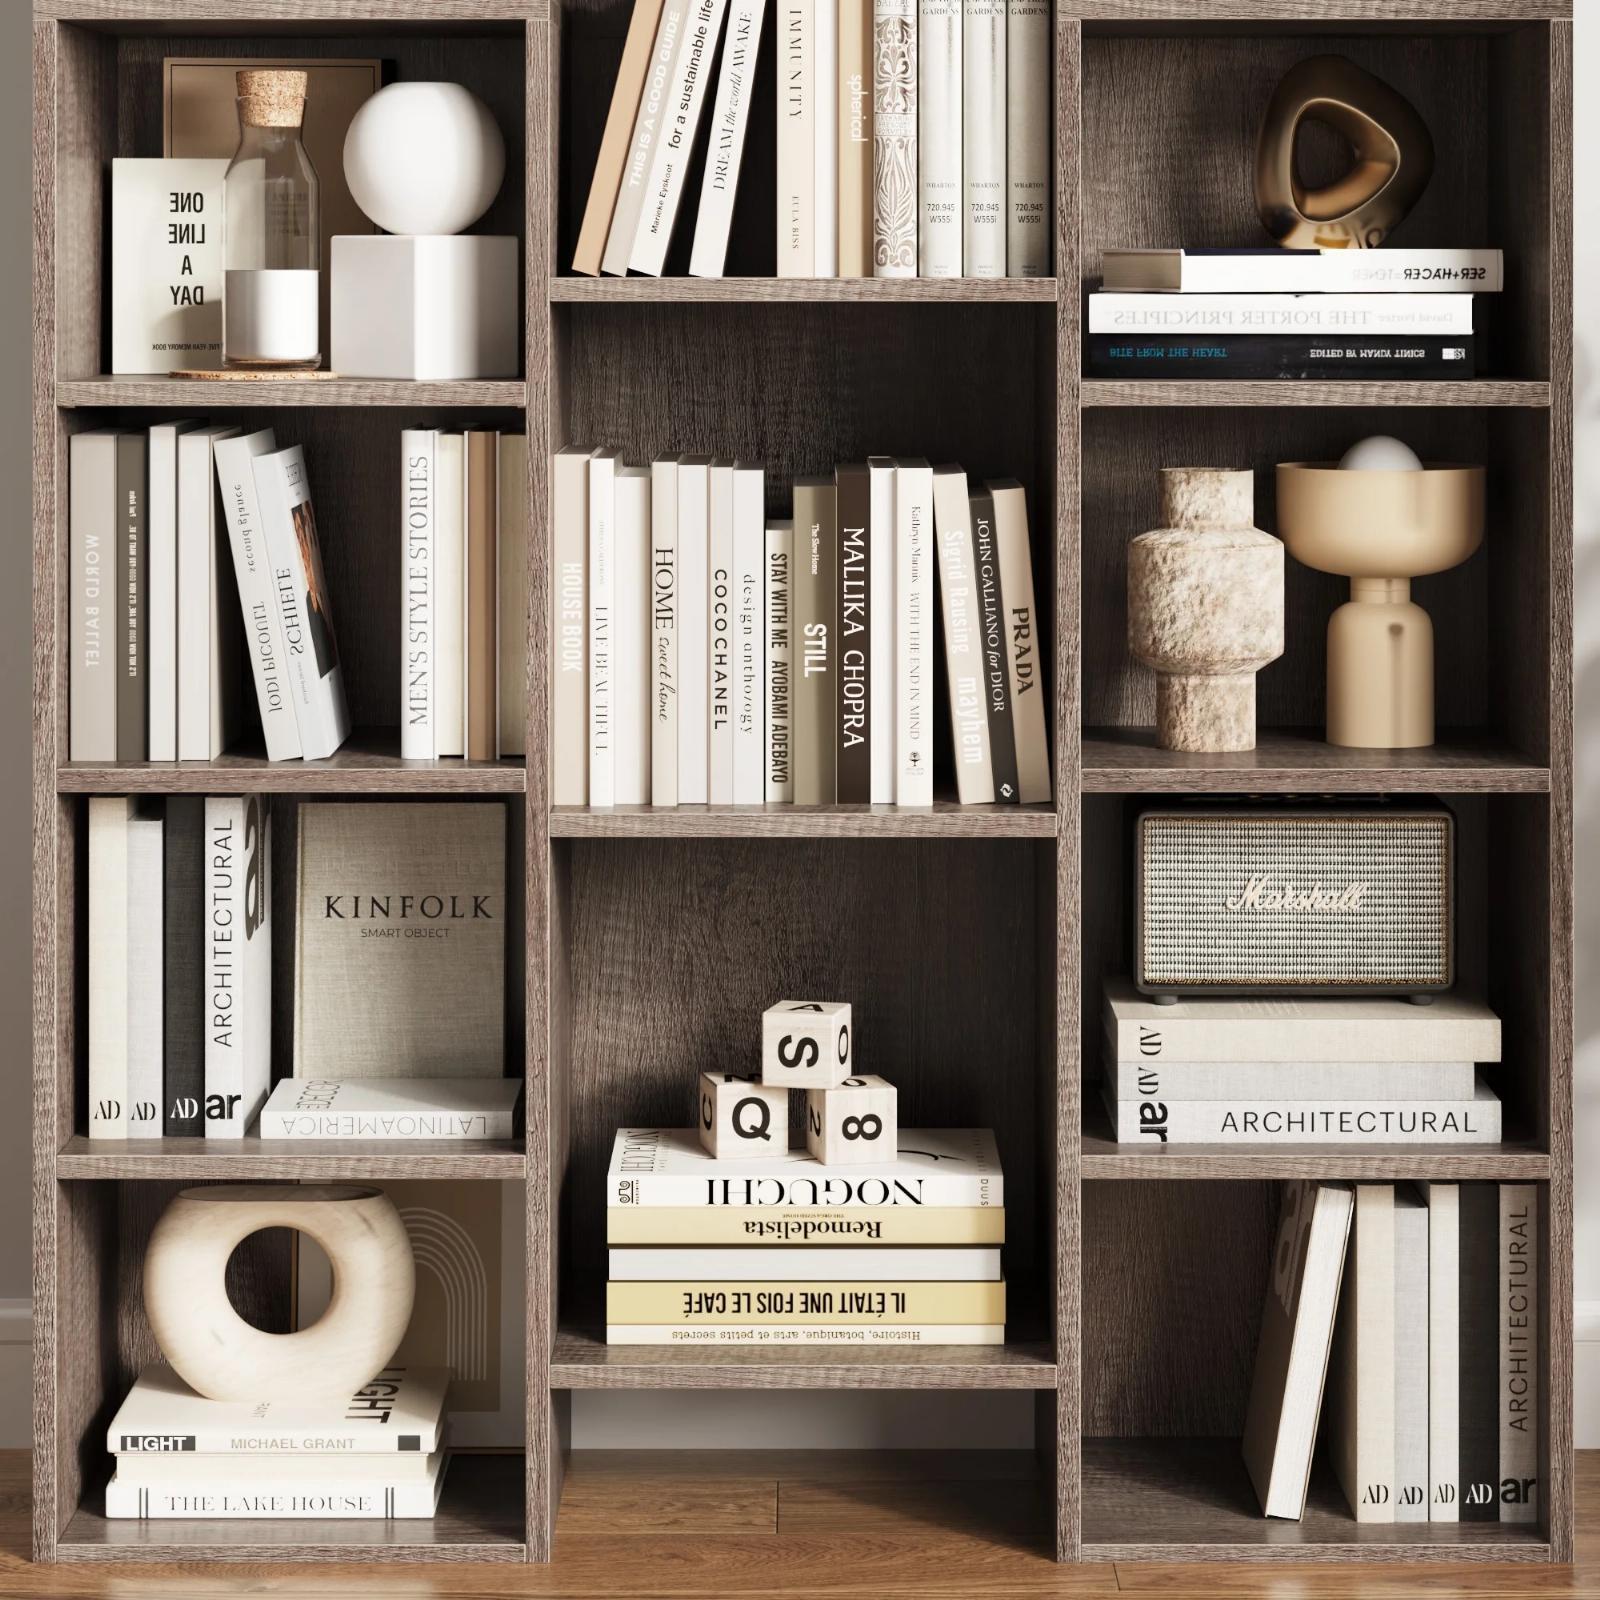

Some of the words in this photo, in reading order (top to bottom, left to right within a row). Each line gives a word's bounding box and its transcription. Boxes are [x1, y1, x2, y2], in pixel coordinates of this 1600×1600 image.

[701, 0, 714, 22] life
[660, 11, 681, 62] GUIDE
[733, 11, 753, 72] AWAKE
[680, 25, 708, 112] sustainable
[788, 10, 802, 120] IMMUNITY
[648, 64, 667, 115] GOOD
[730, 72, 743, 108] world
[677, 114, 686, 125] a
[725, 108, 737, 126] the
[846, 74, 868, 142] spherical
[644, 118, 655, 131] A
[639, 133, 651, 150] IS
[668, 128, 683, 150] for
[630, 152, 646, 187] THIS
[713, 128, 734, 190] DREAM
[651, 198, 666, 234] Marieke
[660, 164, 673, 198] Eyskoot
[927, 204, 955, 212] 720.945
[971, 204, 1000, 212] 720.945
[1016, 204, 1044, 212] 720.945
[792, 227, 800, 250] BISS
[409, 456, 428, 560] STORIES
[812, 524, 820, 538] The
[910, 506, 920, 544] Kathryn
[812, 538, 820, 554] Slow
[977, 518, 992, 562] JOHN
[771, 553, 788, 584] STAY
[812, 554, 820, 575] Home
[911, 548, 920, 584] Mannix
[944, 530, 967, 581] Sigrid
[562, 563, 582, 618] HOUSE
[655, 548, 674, 630] HOME
[843, 528, 866, 637] MALLIKA
[409, 566, 428, 644] STYLE
[740, 574, 756, 636] design
[771, 588, 788, 626] WITH
[910, 592, 920, 625] WITH
[981, 564, 999, 648] GALLIANO
[595, 607, 608, 647] LIVE
[950, 586, 970, 655] Rausing
[562, 625, 582, 672] BOOK
[771, 628, 788, 648] ME
[804, 623, 827, 678] STILL
[910, 629, 920, 654] THE
[1012, 607, 1034, 696] PRADA
[659, 637, 670, 678] sweet
[910, 658, 920, 684] END
[986, 650, 1000, 669] for
[409, 650, 428, 726] MEN'S
[740, 642, 756, 735] anthology
[771, 660, 788, 719] AYOBAMI
[843, 650, 866, 748] CHOPRA
[910, 688, 920, 700] IN
[990, 670, 1005, 712] DIOR
[659, 682, 676, 723] home
[910, 704, 920, 740] MIND
[958, 676, 985, 764] mayhem
[771, 722, 788, 784] ADEBAYO
[1226, 874, 1368, 910] Marshall
[324, 896, 494, 919] KINFOLK
[213, 818, 232, 1048] ARCHITECTURAL
[361, 928, 401, 938] SMART
[404, 928, 450, 938] OBJECT
[788, 1004, 824, 1012] A
[778, 1034, 819, 1068] S
[1140, 1026, 1162, 1056] AD
[1138, 1067, 1159, 1096] AD
[94, 1100, 120, 1120] AD
[131, 1101, 156, 1121] AD
[170, 1098, 198, 1119] AD
[206, 1093, 242, 1120] ar
[732, 1096, 771, 1142] Q
[281, 1116, 486, 1135] LATINOAMERICA
[842, 1114, 882, 1140] 8
[1139, 1102, 1168, 1142] ar
[1220, 1112, 1478, 1133] ARCHITECTURAL
[706, 1178, 924, 1205] NOGUCHI
[980, 1178, 989, 1206] DUUS
[743, 1221, 883, 1240] Remodelista
[683, 1292, 726, 1318] CAFÉ
[732, 1292, 750, 1314] LE
[756, 1292, 794, 1314] FOIS
[800, 1292, 833, 1314] UNE
[838, 1292, 886, 1318] ÉTAIT
[890, 1292, 906, 1314] IL
[1508, 1206, 1528, 1432] ARCHITECTURAL
[672, 1331, 716, 1340] secrets
[720, 1330, 754, 1340] petits
[758, 1331, 770, 1340] et
[773, 1331, 800, 1340] arts
[803, 1330, 864, 1340] botanique,
[868, 1330, 921, 1340] Histoire,
[126, 1436, 187, 1451] LIGHT
[231, 1438, 298, 1449] MICHAEL
[303, 1438, 356, 1449] GRANT
[164, 1496, 215, 1512] THE
[222, 1496, 284, 1512] LAKE
[292, 1496, 372, 1512] HOUSE
[1362, 1484, 1389, 1504] AD
[1398, 1486, 1424, 1505] AD
[1434, 1484, 1456, 1504] AD
[1466, 1484, 1493, 1504] AD
[1501, 1478, 1536, 1504] ar
